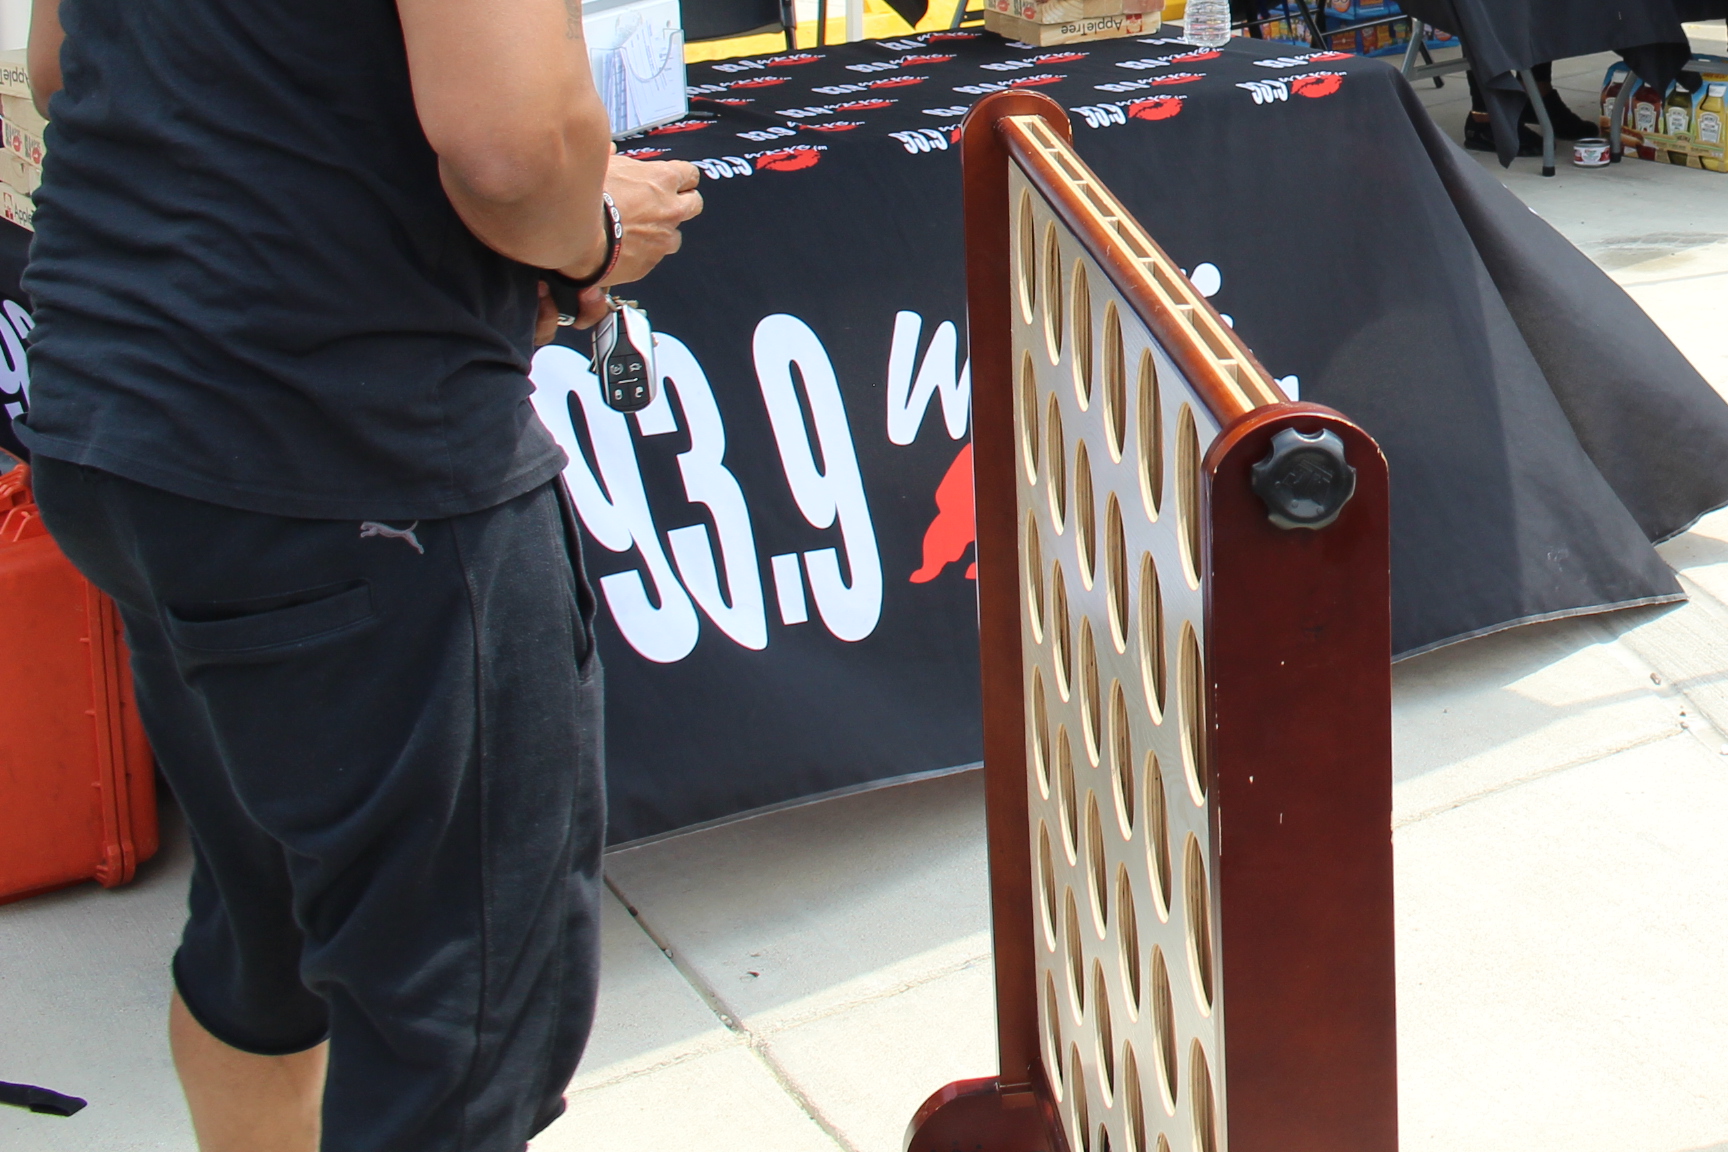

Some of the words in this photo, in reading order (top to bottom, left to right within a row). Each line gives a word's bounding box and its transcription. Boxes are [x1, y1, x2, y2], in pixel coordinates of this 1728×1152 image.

[1060, 18, 1123, 36] AppleTree
[15, 204, 33, 226] Apple
[531, 313, 883, 664] 93.9
